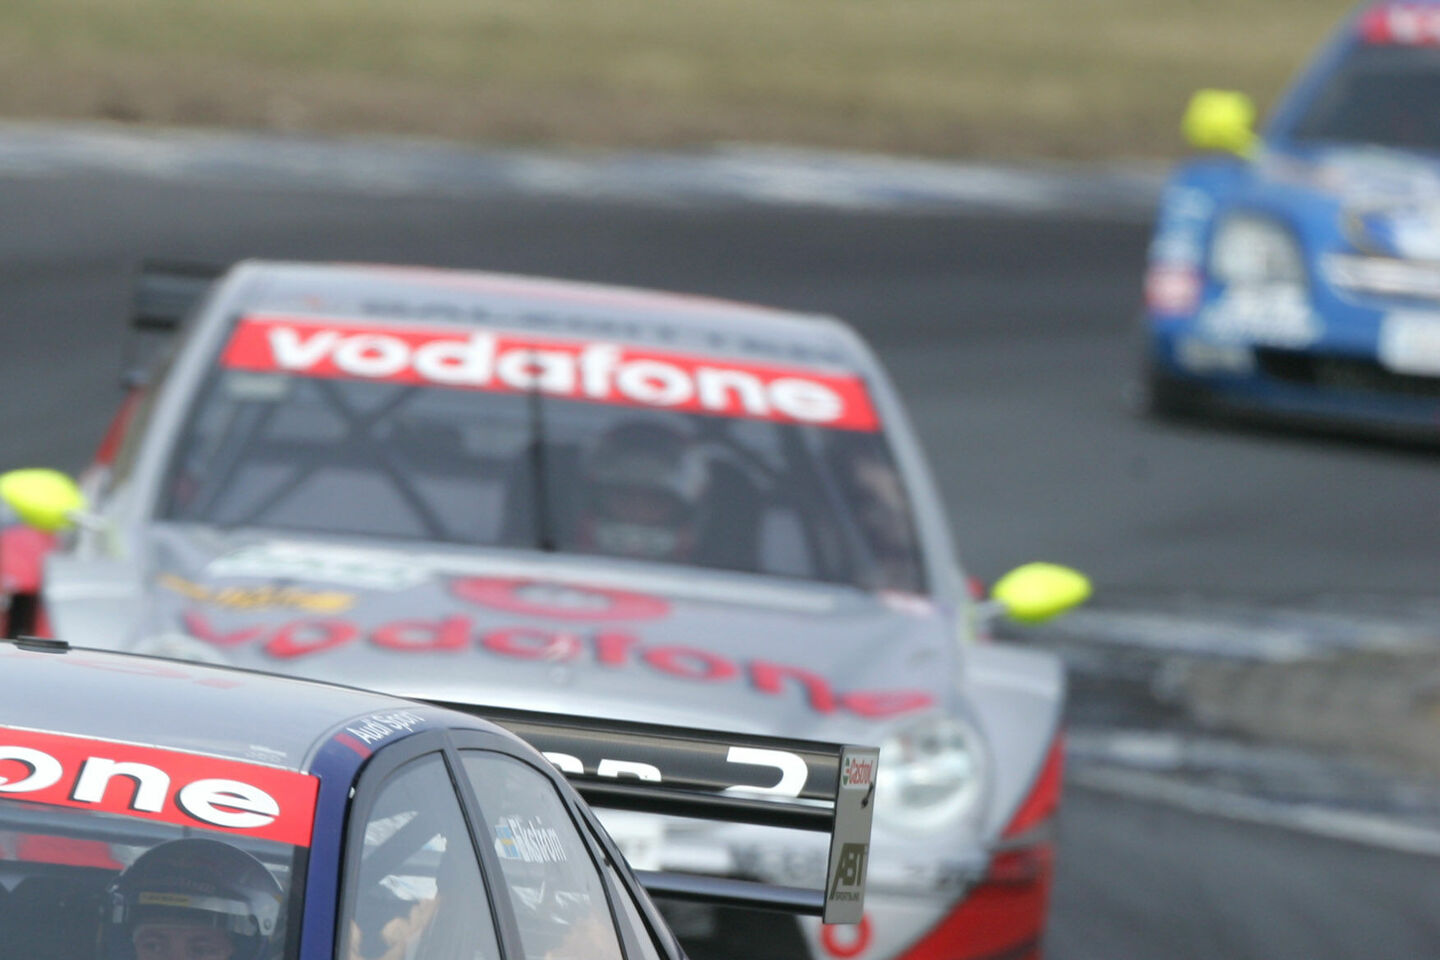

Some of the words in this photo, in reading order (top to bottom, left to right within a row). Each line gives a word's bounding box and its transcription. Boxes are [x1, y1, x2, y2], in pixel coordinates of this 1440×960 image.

[267, 326, 845, 423] vodafone
[182, 610, 934, 718] vodafone
[345, 713, 394, 745] Audi
[828, 842, 866, 900] ABT
